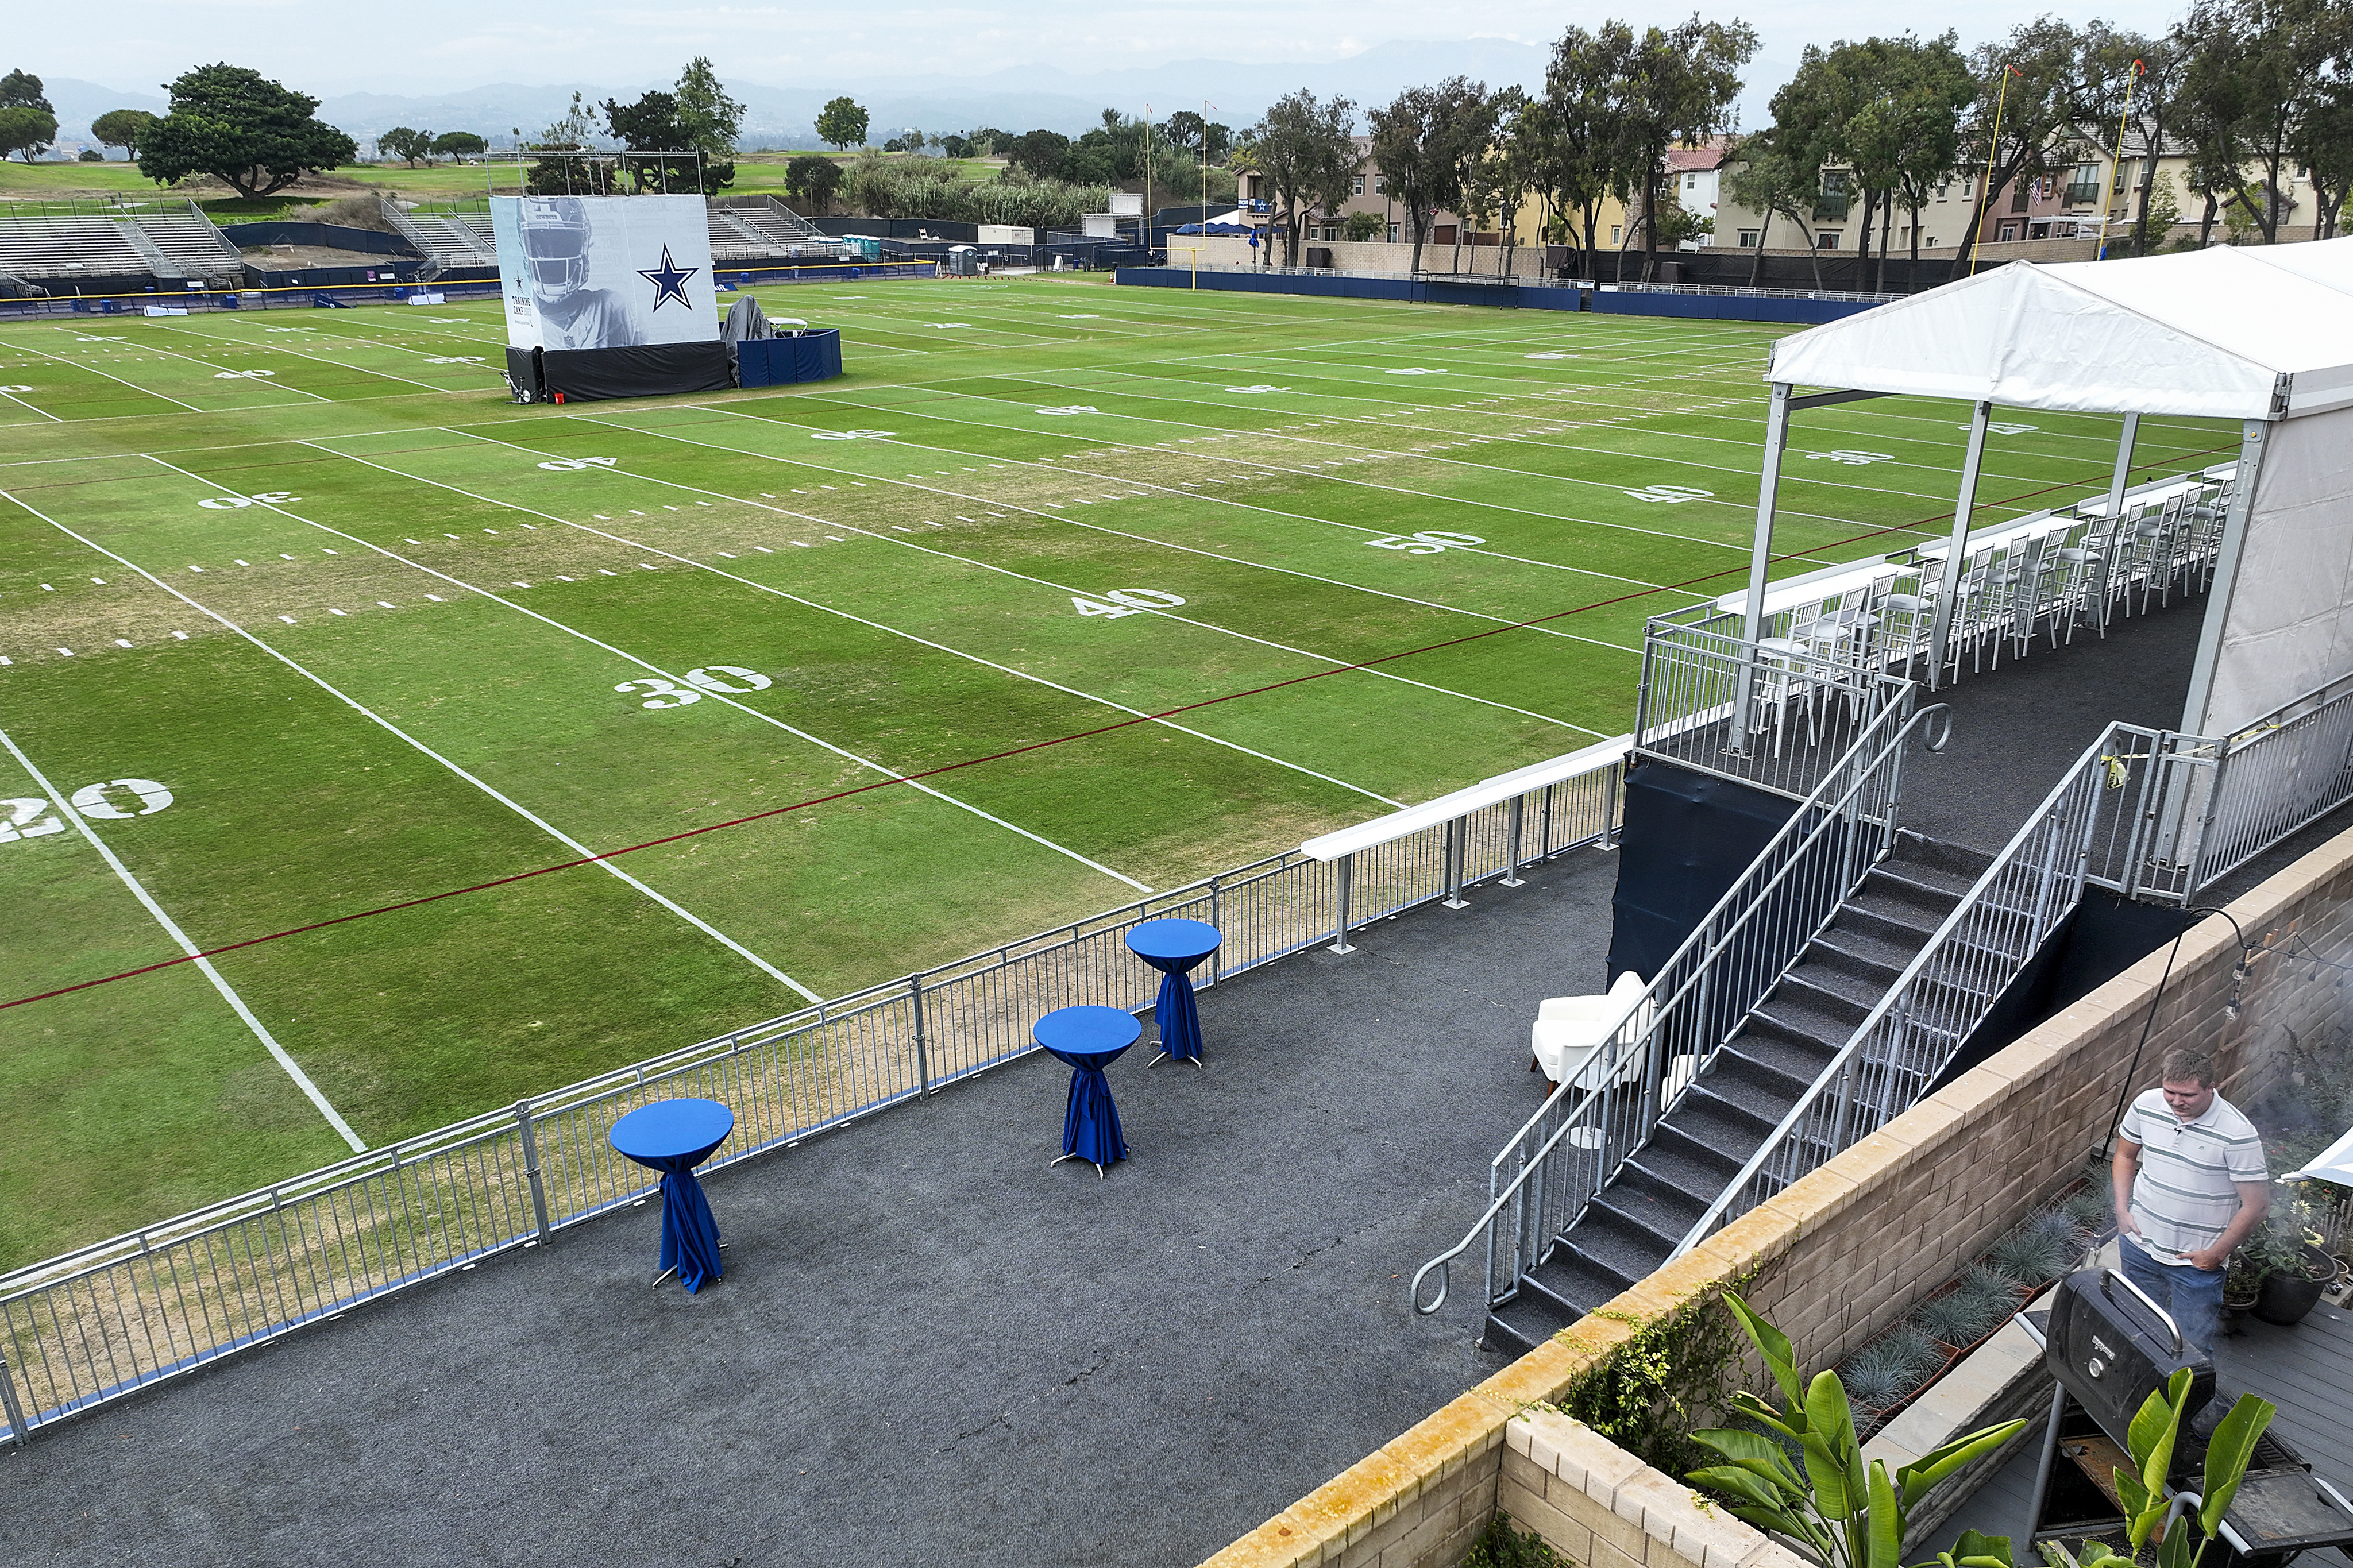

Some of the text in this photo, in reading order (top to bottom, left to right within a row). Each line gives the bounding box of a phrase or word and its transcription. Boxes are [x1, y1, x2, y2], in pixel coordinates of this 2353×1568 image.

[512, 296, 530, 306] TRAINING
[513, 306, 523, 315] CAMP
[811, 429, 898, 440] 50
[537, 457, 618, 470] 40
[1806, 450, 1895, 465] 30
[197, 492, 303, 509] 30
[1622, 485, 1714, 504] 40
[1363, 531, 1486, 554] 50
[1071, 588, 1186, 619] 40
[614, 666, 772, 709] 30
[0, 778, 174, 844] 20
